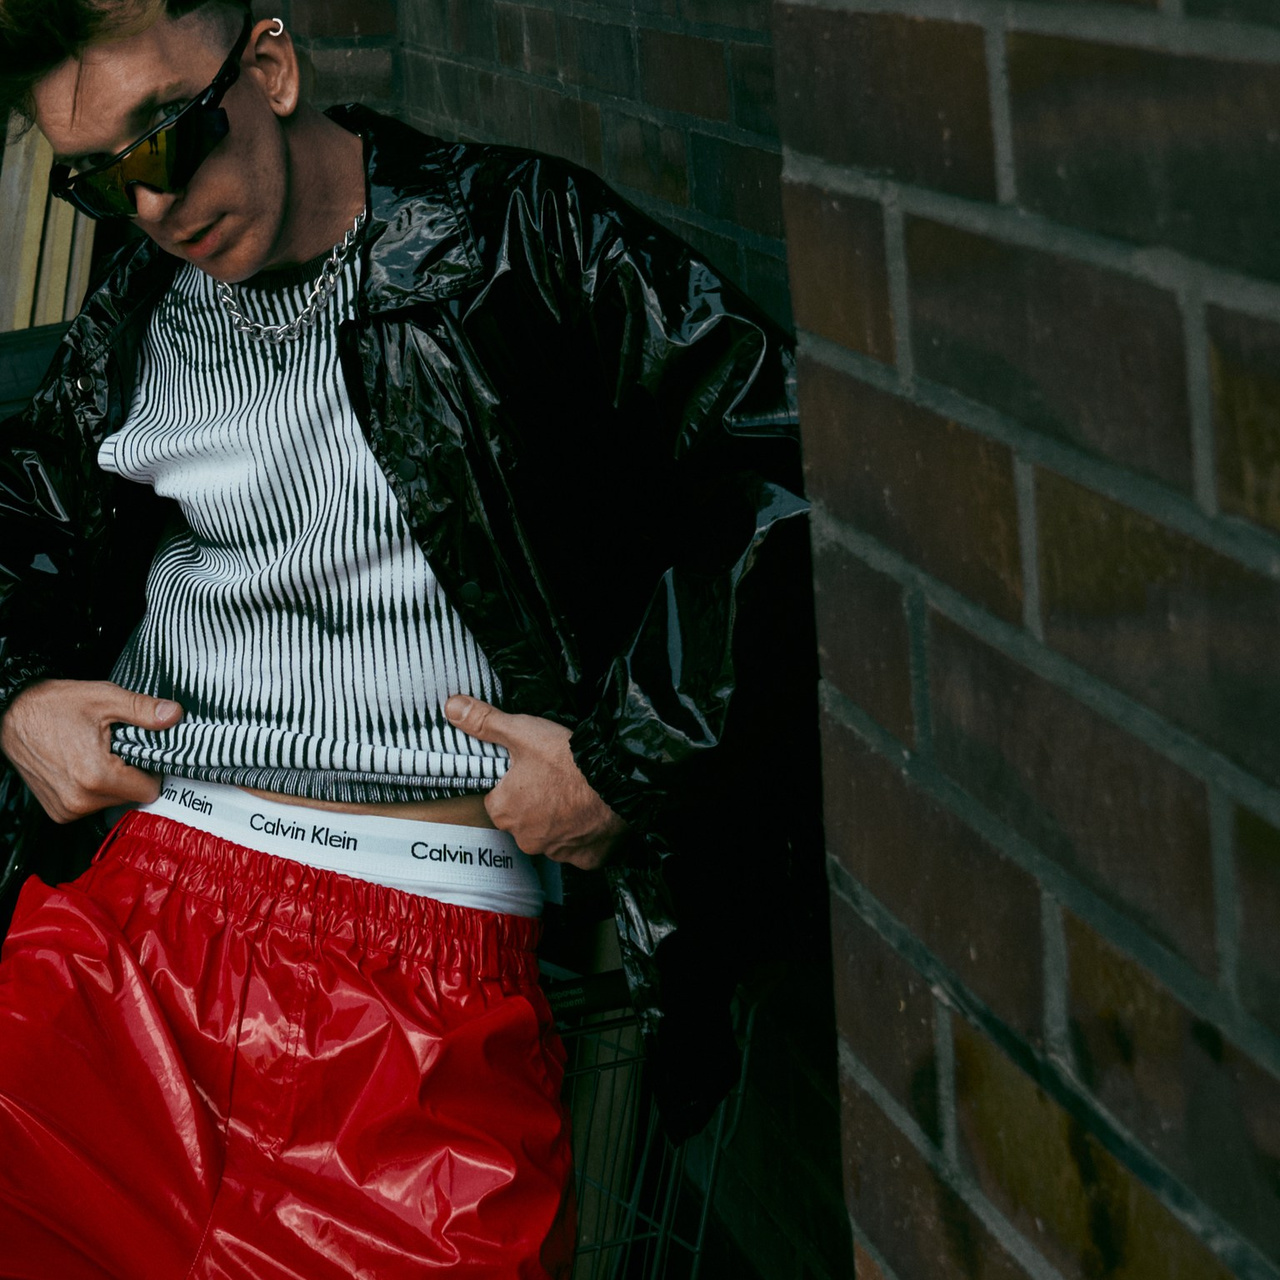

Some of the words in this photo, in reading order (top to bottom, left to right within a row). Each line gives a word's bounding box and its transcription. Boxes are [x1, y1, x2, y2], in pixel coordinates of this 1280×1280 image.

[161, 783, 178, 802] vin
[178, 787, 213, 816] Klein
[250, 813, 306, 841] Calvin
[311, 825, 358, 851] Klein
[411, 841, 473, 866] Calvin
[478, 847, 513, 869] Klein
